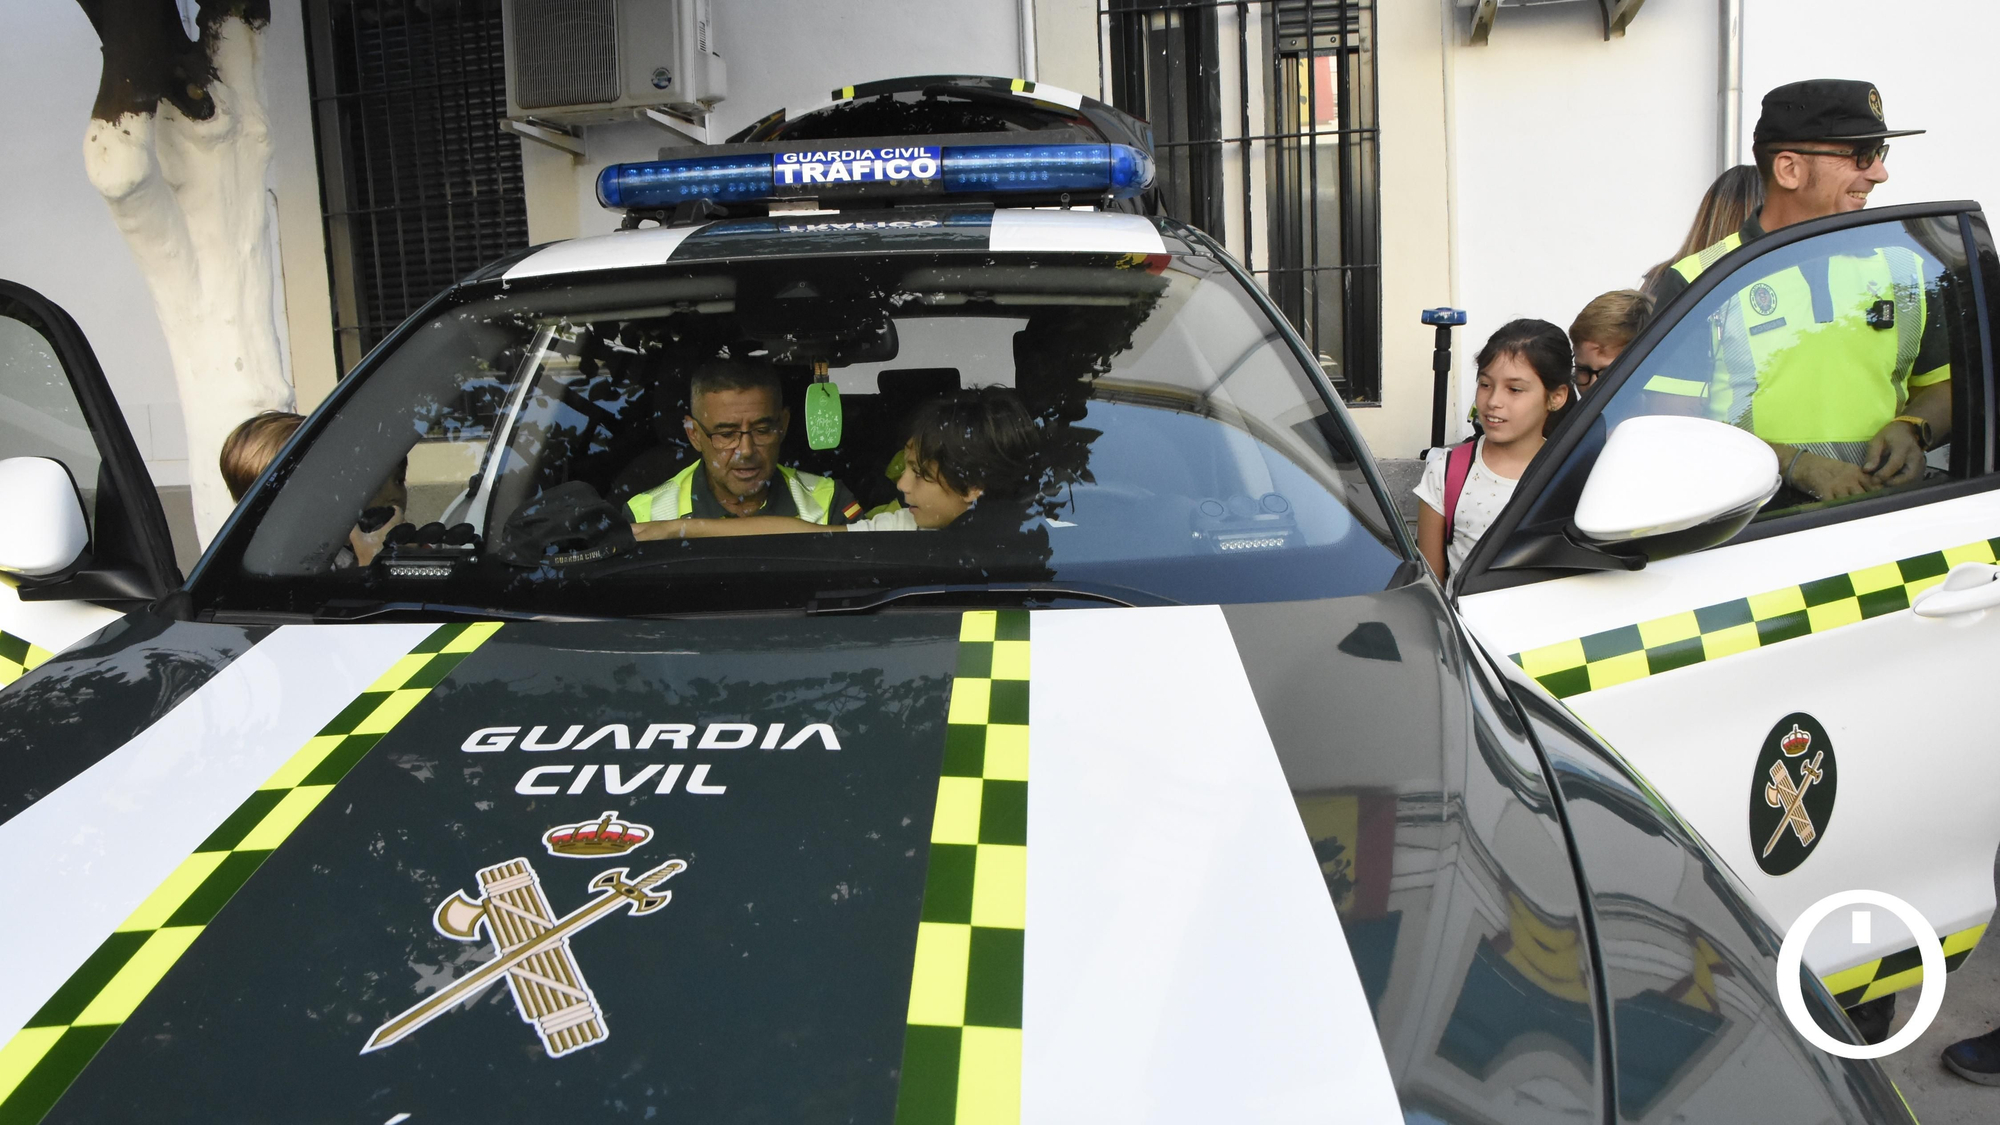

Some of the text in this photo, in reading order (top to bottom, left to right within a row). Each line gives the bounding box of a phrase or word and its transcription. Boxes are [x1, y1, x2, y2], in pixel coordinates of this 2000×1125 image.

[783, 147, 932, 164] GUARDIA CIVIL
[461, 723, 842, 752] GUARDIA
[515, 764, 727, 795] CIVIL
